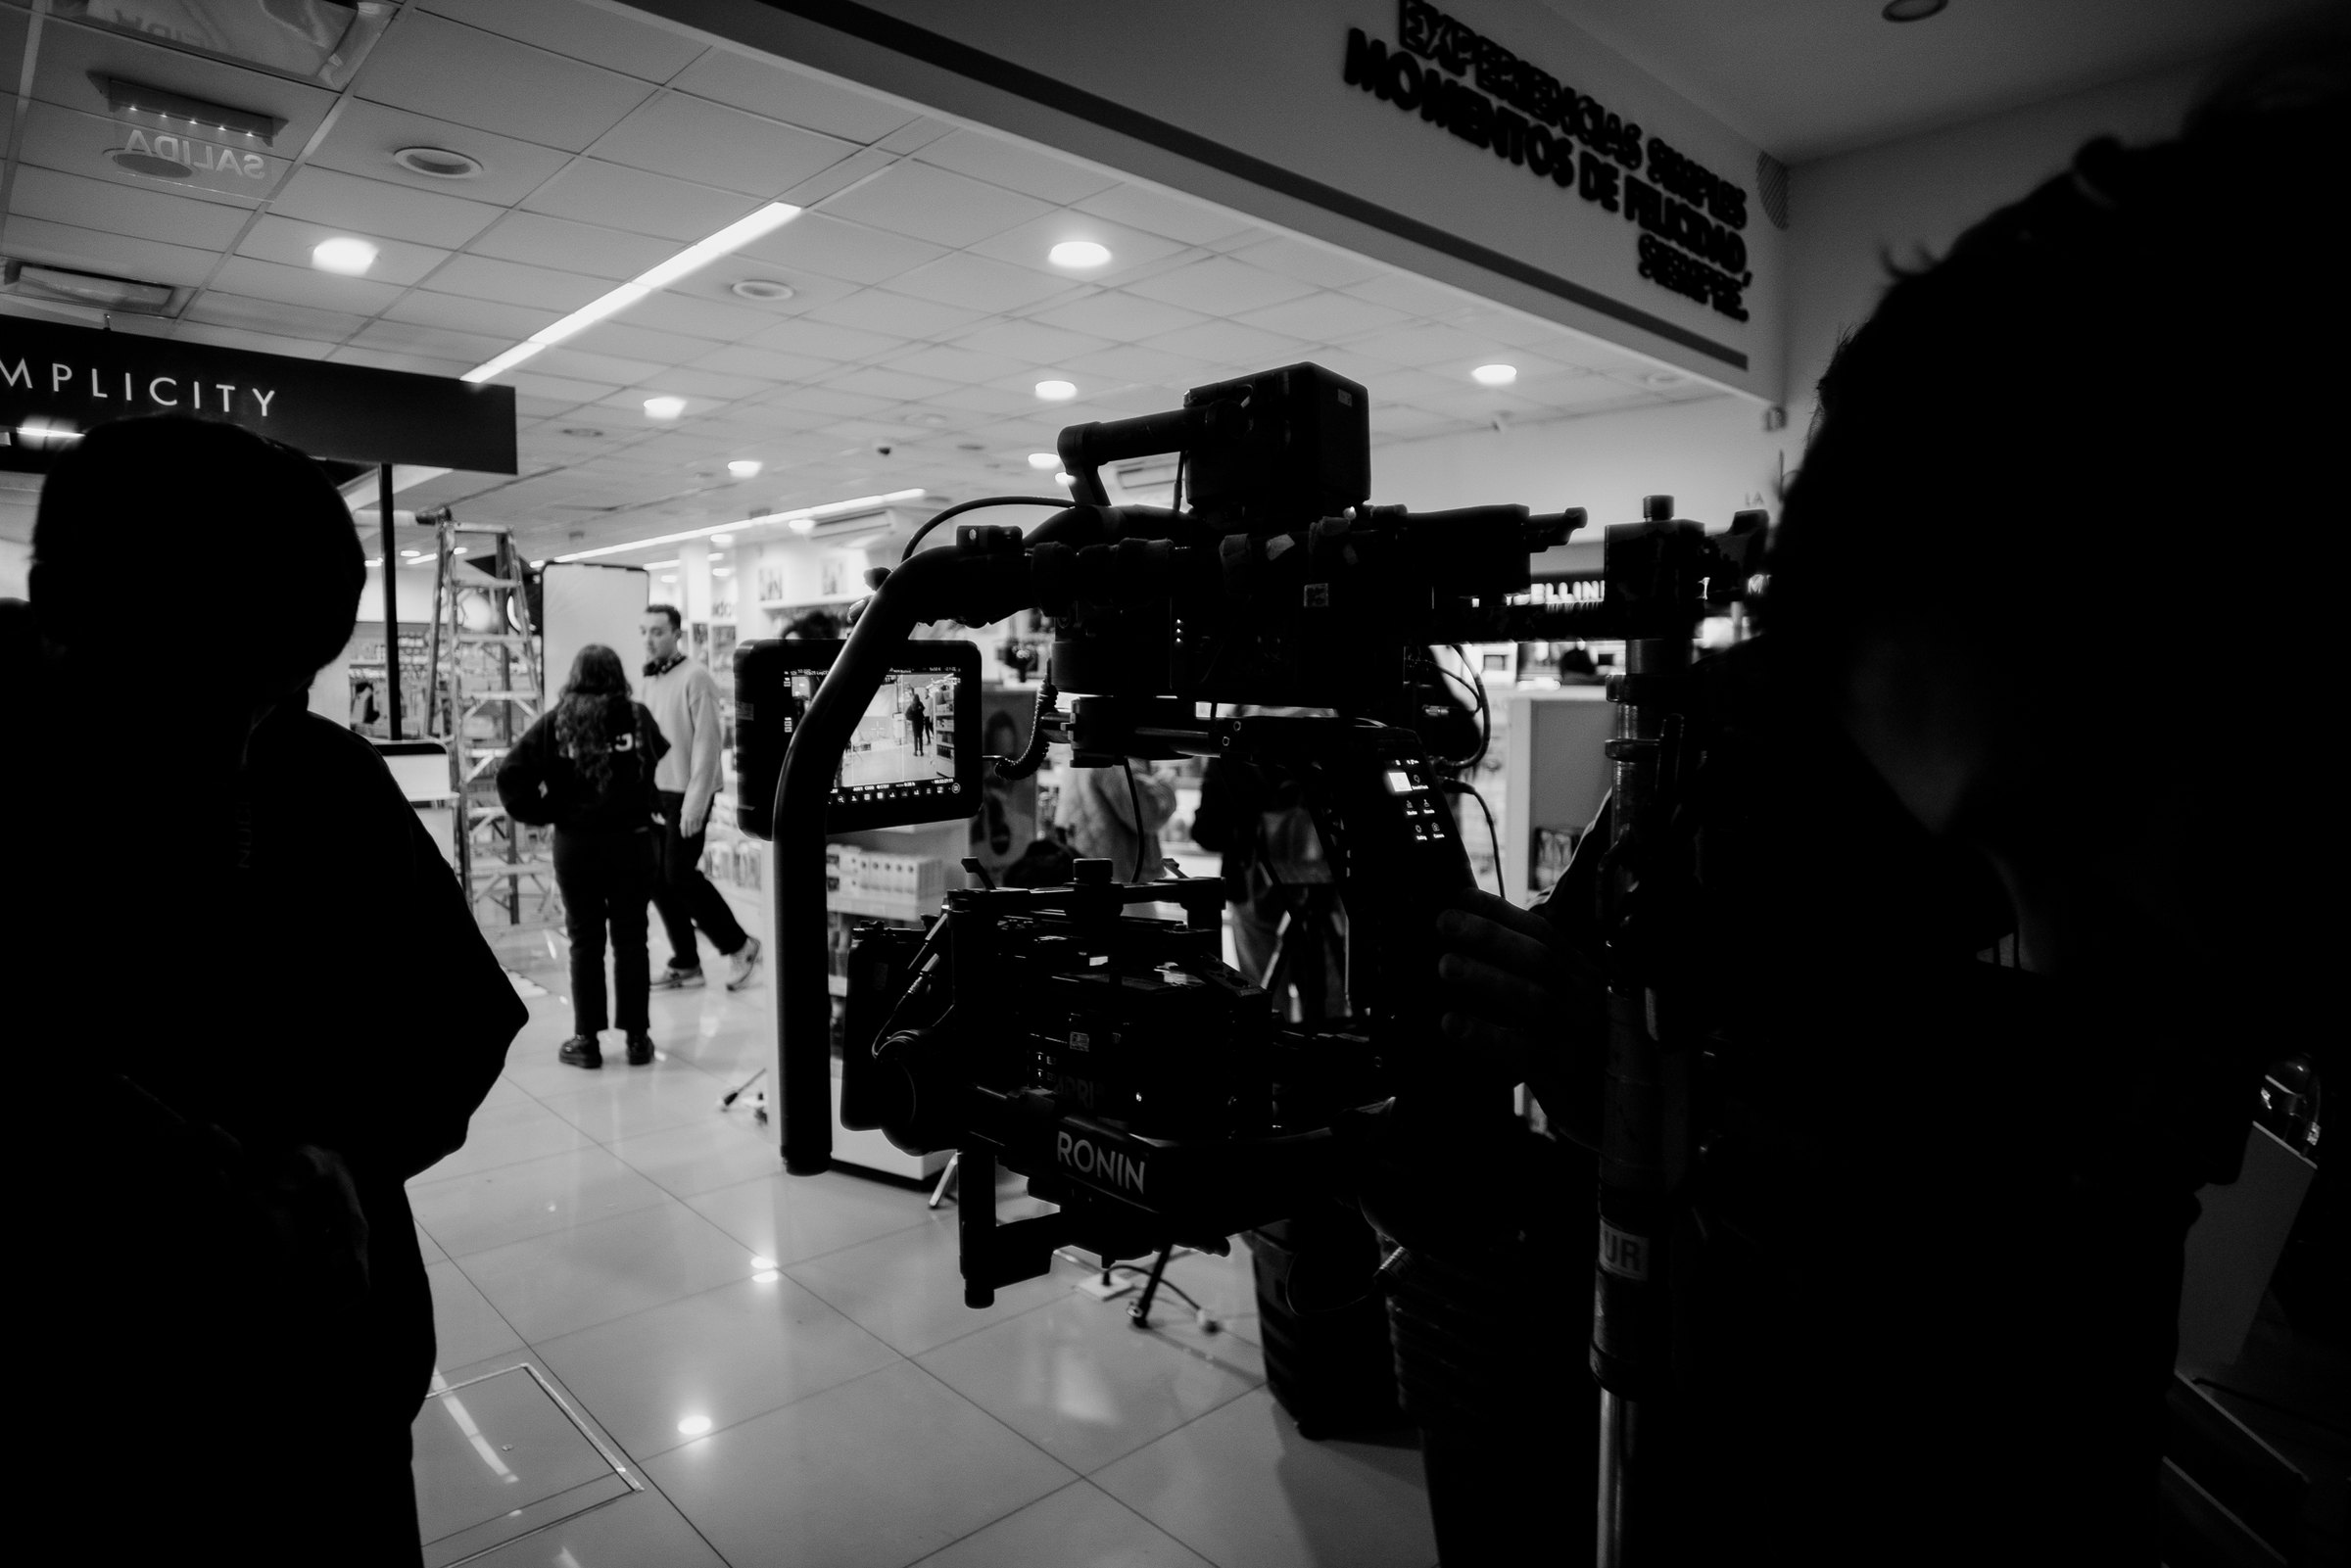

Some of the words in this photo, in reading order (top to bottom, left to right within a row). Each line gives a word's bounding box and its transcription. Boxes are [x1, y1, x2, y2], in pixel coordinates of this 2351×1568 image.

[1344, 27, 1574, 188] MOMENTOS
[1579, 151, 1619, 214] DE
[1399, 0, 1643, 170] EXPERIENCIAS
[1057, 1130, 1145, 1195] RONIN
